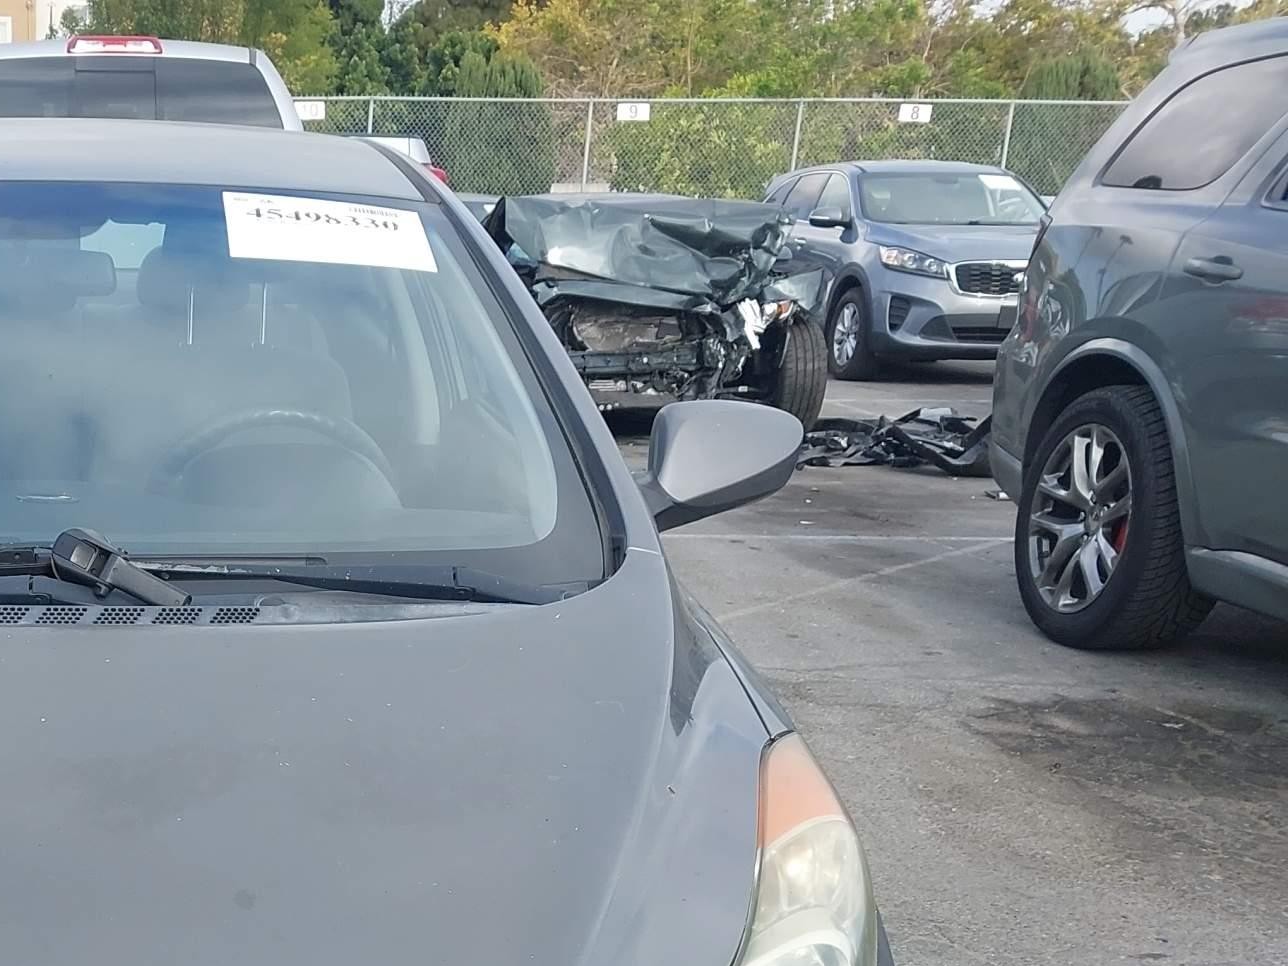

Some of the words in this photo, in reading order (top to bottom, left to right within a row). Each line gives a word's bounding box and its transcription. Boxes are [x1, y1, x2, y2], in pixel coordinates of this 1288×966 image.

[629, 104, 638, 119] 9
[911, 105, 920, 120] 8
[246, 207, 399, 231] 45498330
